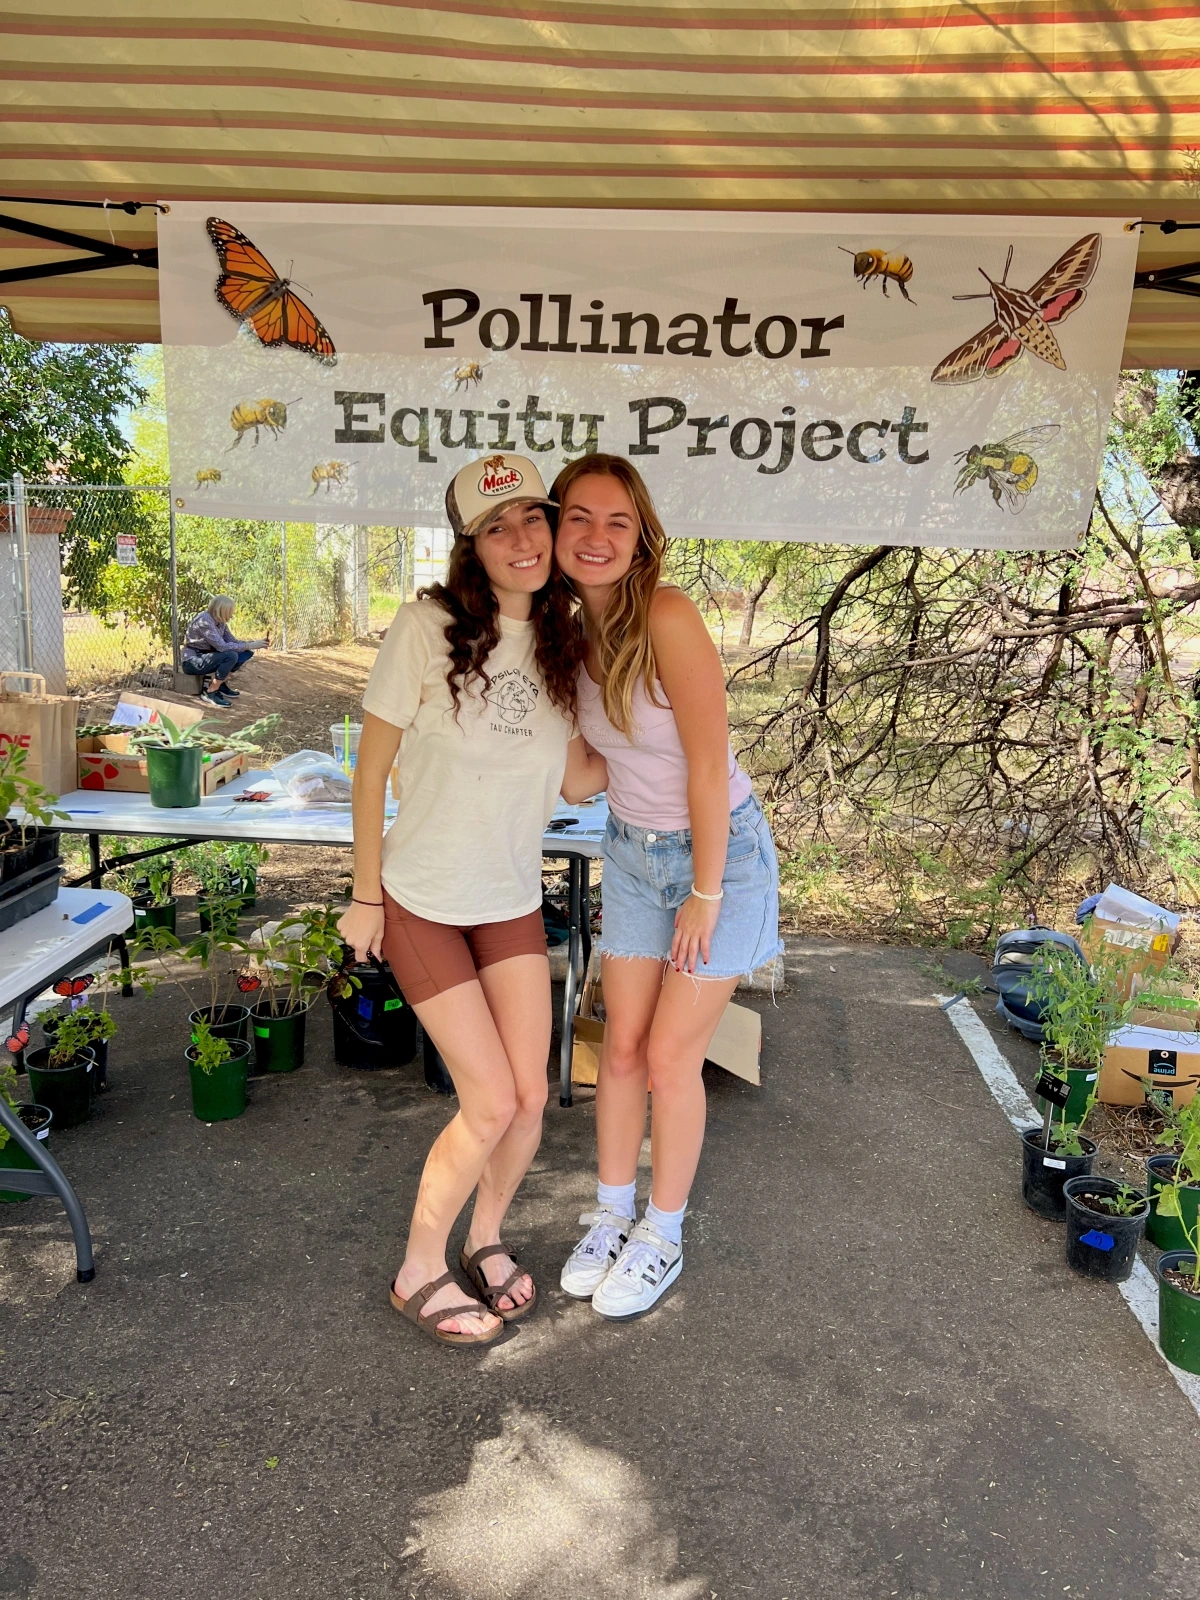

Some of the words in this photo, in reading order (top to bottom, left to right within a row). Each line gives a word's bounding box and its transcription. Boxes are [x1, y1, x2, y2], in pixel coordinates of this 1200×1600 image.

[422, 289, 845, 360] Pollinator
[334, 391, 604, 464] Equity
[628, 396, 930, 475] Project
[483, 470, 520, 492] Mack
[492, 483, 516, 494] TRUCKS
[522, 674, 539, 698] ETA
[490, 723, 502, 732] TAU
[504, 725, 533, 737] CHAPTER
[1153, 1067, 1176, 1075] prime
